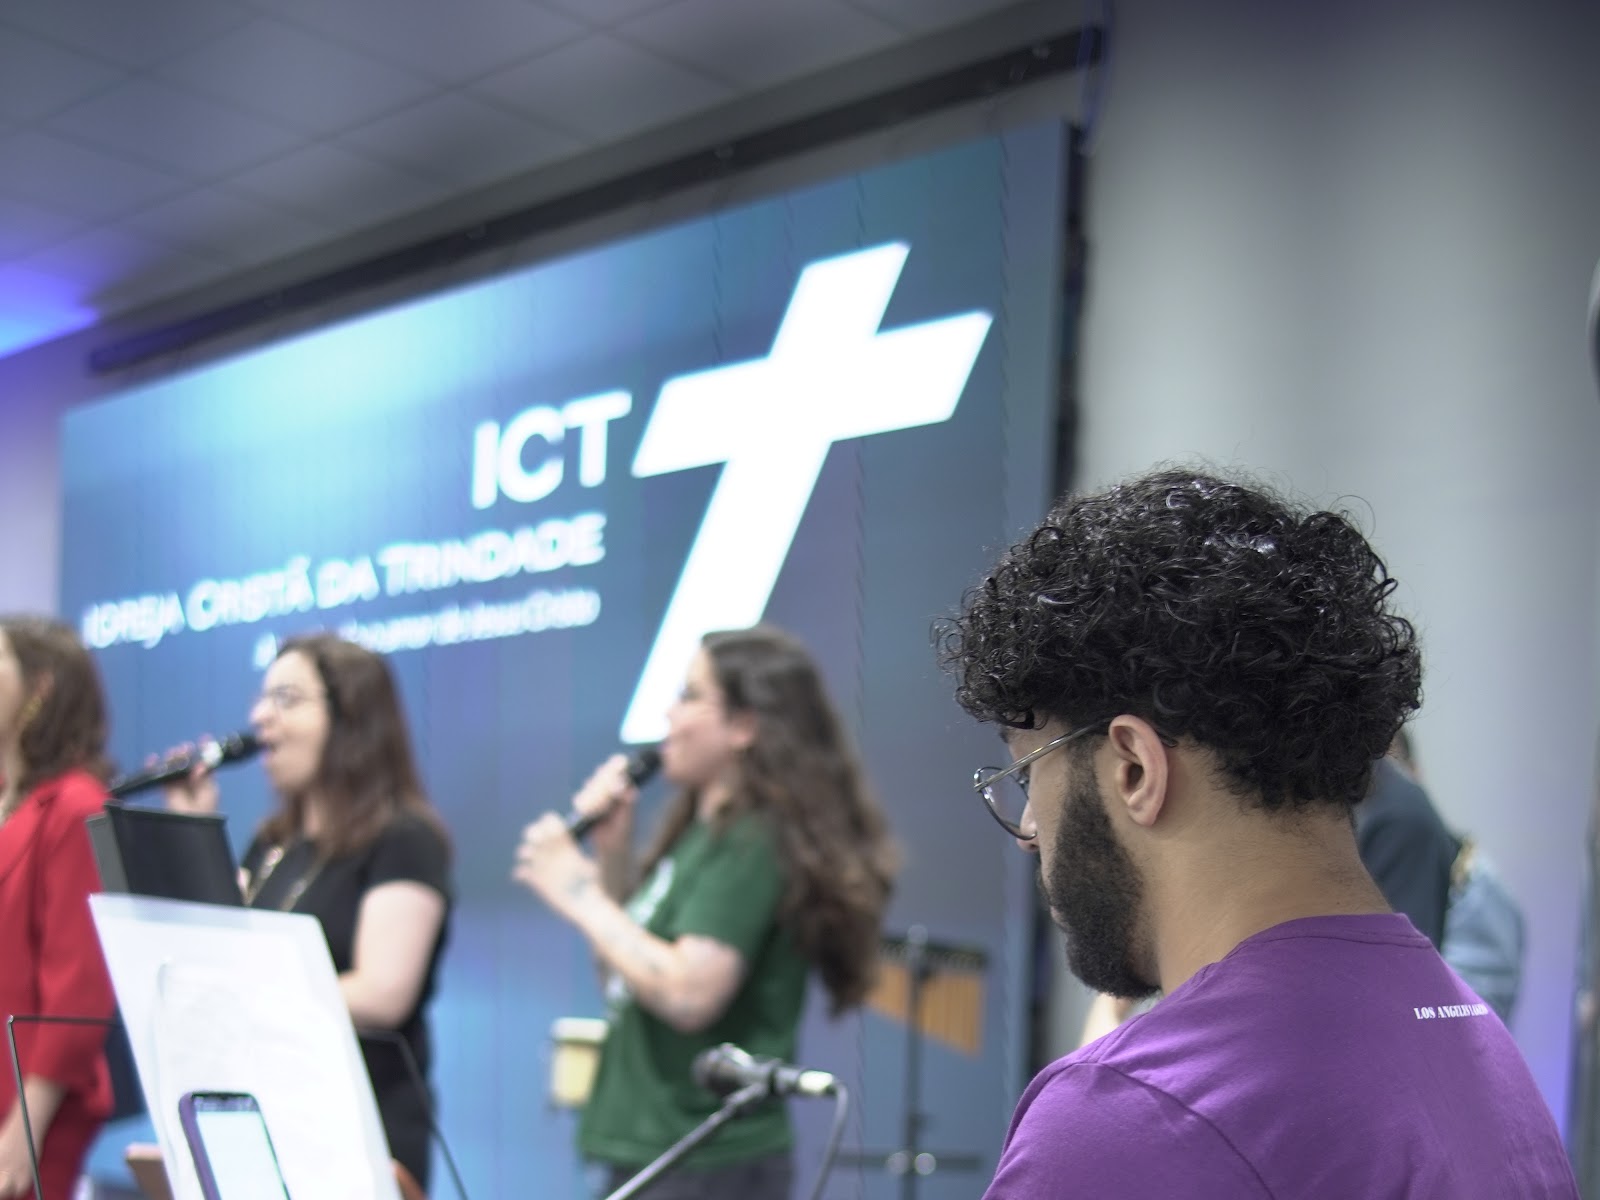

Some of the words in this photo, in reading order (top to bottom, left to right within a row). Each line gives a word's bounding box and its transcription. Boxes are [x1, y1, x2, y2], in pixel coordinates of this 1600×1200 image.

[471, 390, 632, 509] ICT
[317, 560, 380, 608] DA
[379, 513, 606, 596] TRINDADE
[1413, 1006, 1436, 1020] LOS
[1437, 1004, 1471, 1019] ANGELES
